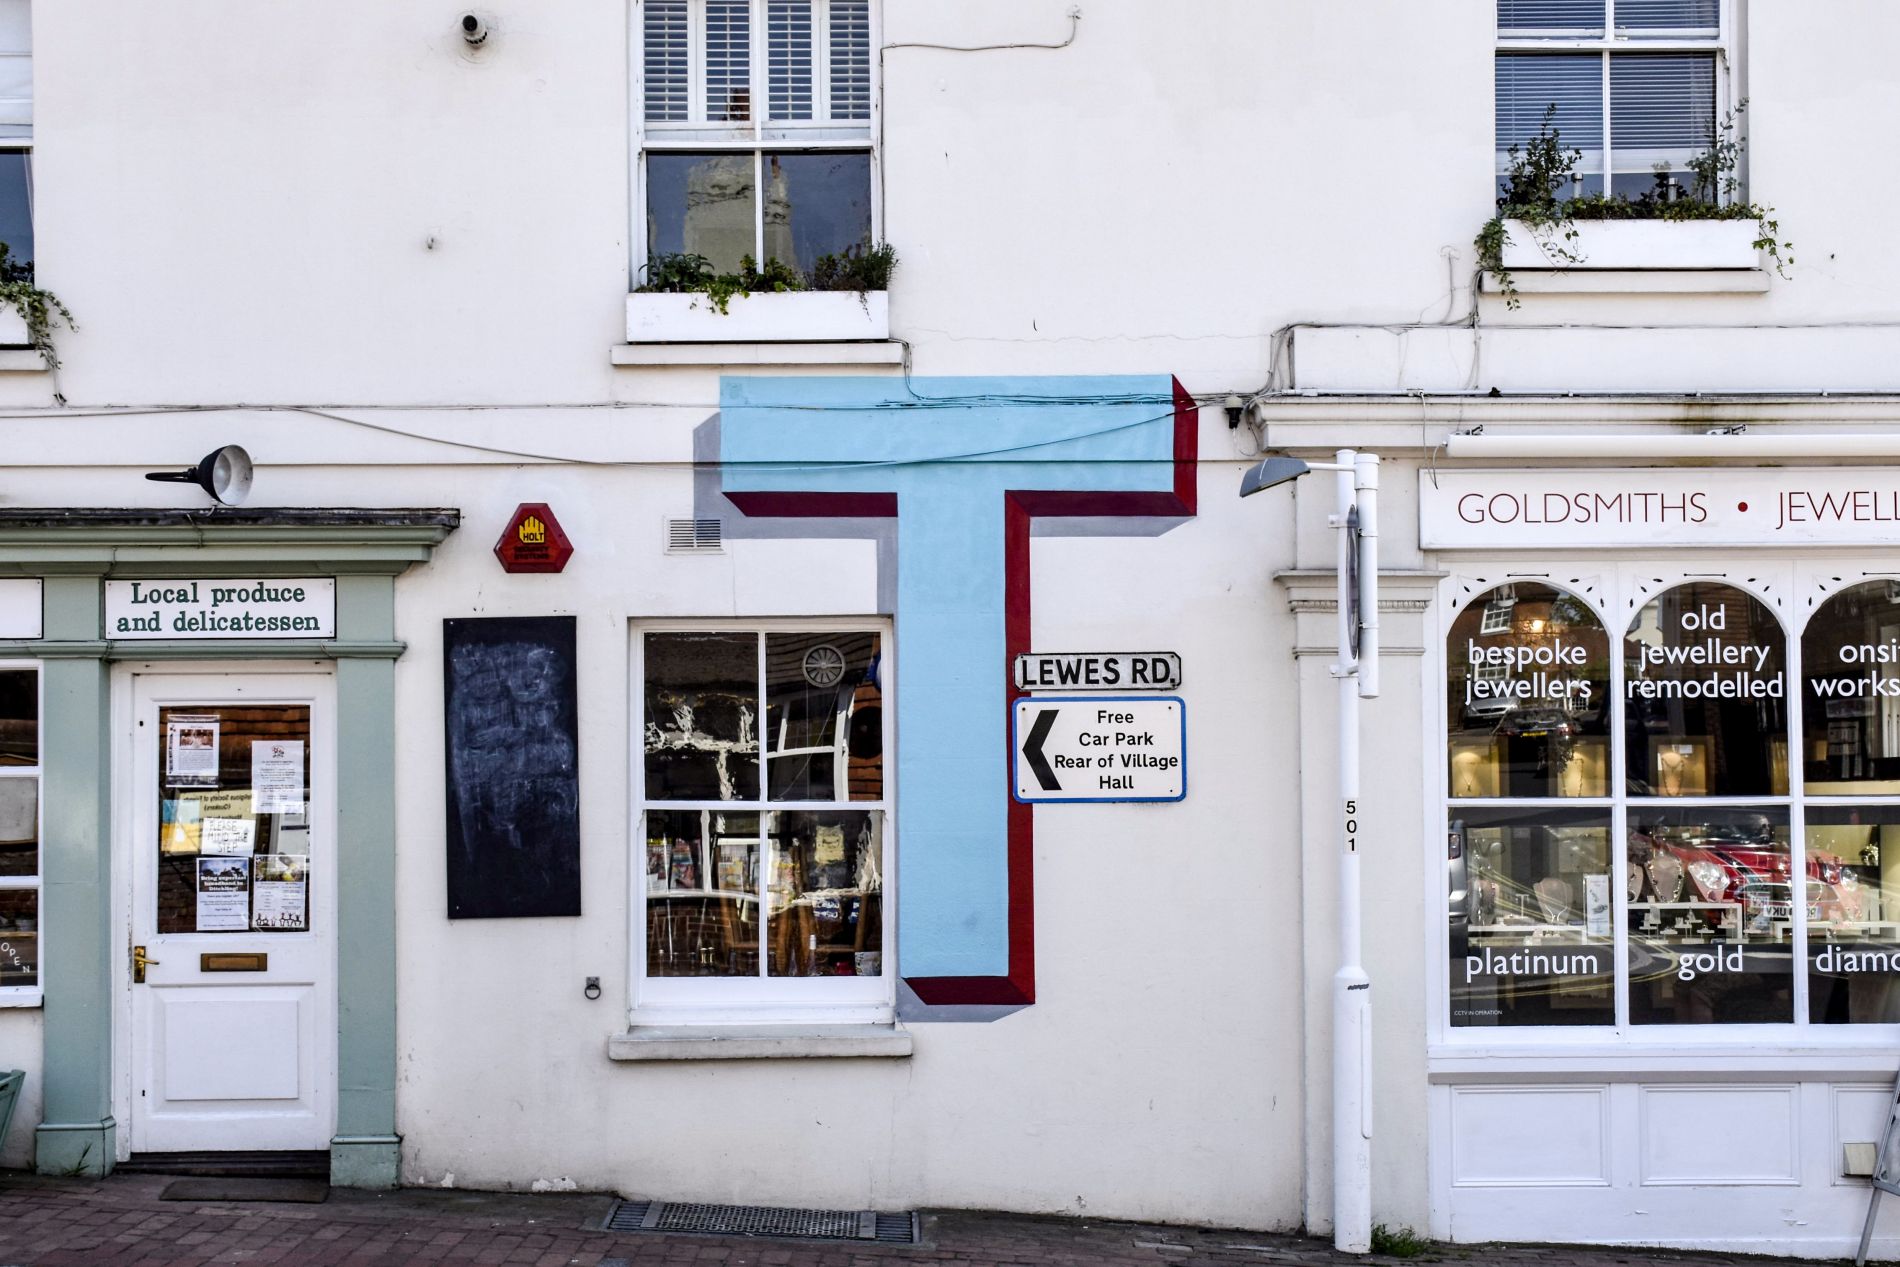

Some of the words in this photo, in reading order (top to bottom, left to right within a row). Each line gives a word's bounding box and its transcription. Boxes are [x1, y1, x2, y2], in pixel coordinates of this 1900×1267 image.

[1457, 492, 1708, 524] GOLDSMITHS
[1775, 490, 1900, 530] JEWELL
[523, 532, 544, 541] HOLT
[131, 582, 200, 604] Local
[211, 582, 305, 606] produce
[116, 611, 162, 633] and
[173, 611, 320, 633] delicatessen
[1681, 603, 1726, 630] old
[1468, 638, 1587, 673] bespoke
[1640, 637, 1770, 672] jewellery
[1839, 638, 1900, 663] onsi
[1022, 658, 1121, 685] LEWES
[1131, 658, 1176, 684] RD.
[1627, 671, 1783, 698] remodelled
[1811, 670, 1900, 697] works
[1465, 672, 1592, 705] jewellers
[1097, 710, 1134, 724] Free
[1078, 732, 1109, 747] Car
[1115, 731, 1154, 746] Park
[1054, 754, 1092, 769] Rear
[1097, 754, 1114, 768] of
[1120, 753, 1179, 771] Village
[1099, 775, 1135, 790] Hall
[209, 820, 238, 832] PLEASE
[218, 842, 238, 853] STEP
[1, 942, 30, 973] OPEN
[1466, 948, 1598, 983] platinum
[1679, 945, 1743, 981] gold
